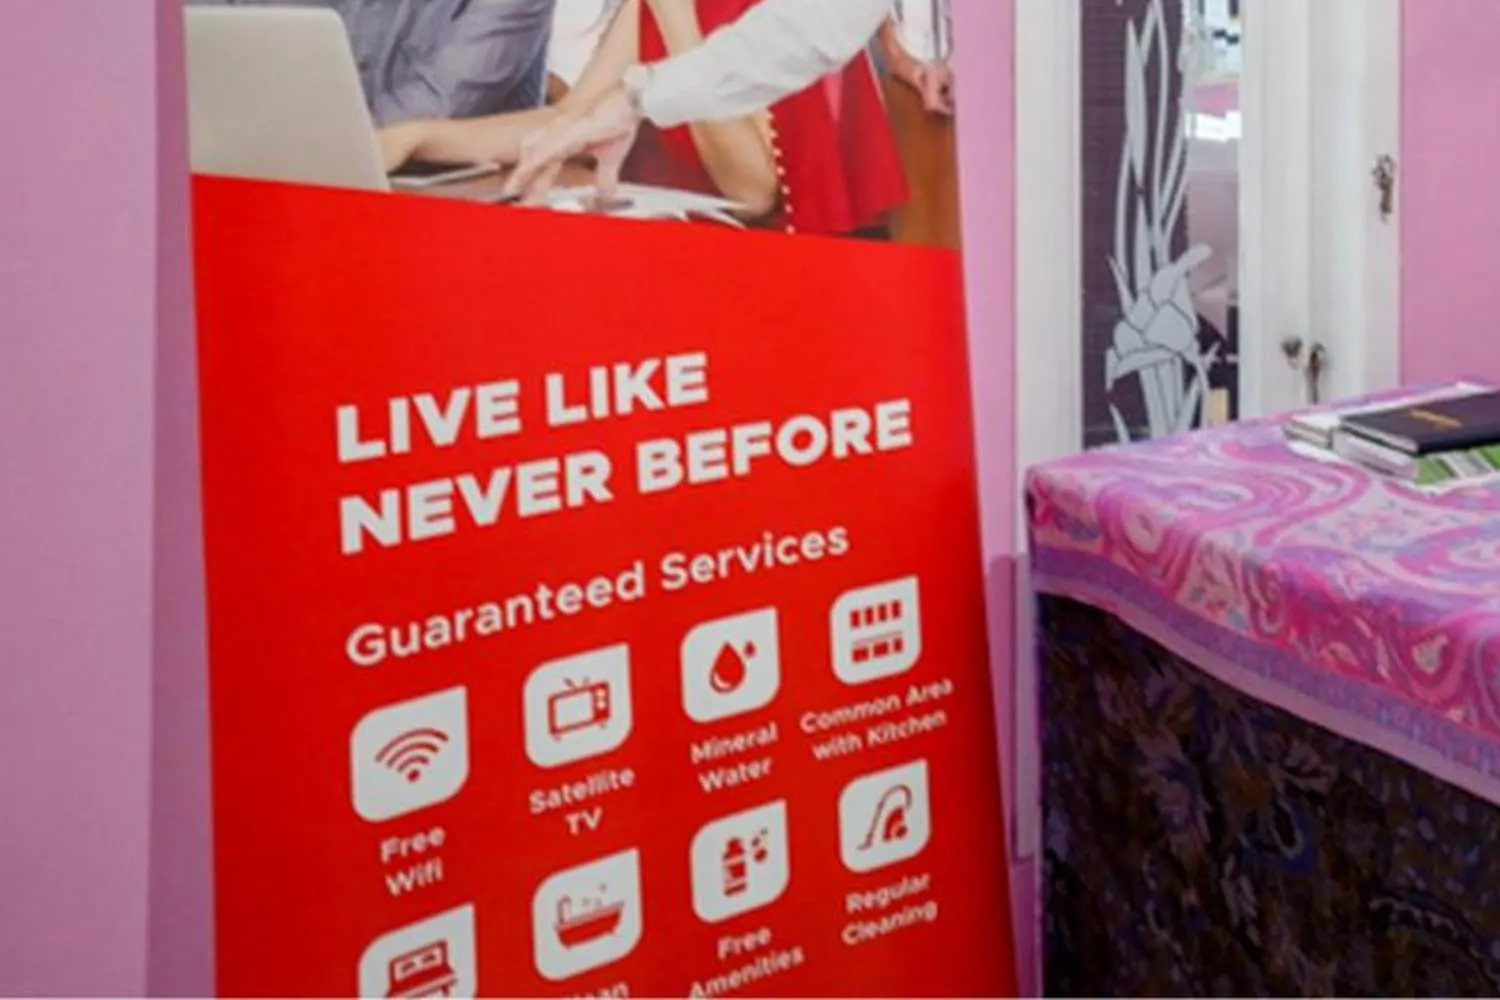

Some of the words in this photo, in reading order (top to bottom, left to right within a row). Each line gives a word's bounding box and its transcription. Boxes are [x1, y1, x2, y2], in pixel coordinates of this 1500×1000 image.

[336, 380, 521, 463] LIVE
[544, 352, 710, 427] LIKE
[339, 450, 614, 555] NEVER
[635, 398, 914, 493] BEFORE
[344, 561, 646, 666] Guaranteed
[660, 524, 850, 592] Services
[800, 694, 901, 734] Common
[905, 678, 954, 706] Area
[690, 722, 779, 765] Mineral
[812, 733, 863, 761] with
[866, 709, 948, 747] Kitchen
[528, 765, 636, 814] Satellite
[697, 757, 773, 794] Water
[379, 825, 447, 864] Free
[564, 807, 604, 836] TV
[384, 859, 445, 897] Wifi
[845, 872, 930, 914] Regular
[716, 926, 772, 961] Free
[840, 899, 939, 946] Cleaning
[688, 945, 805, 999] Amenities
